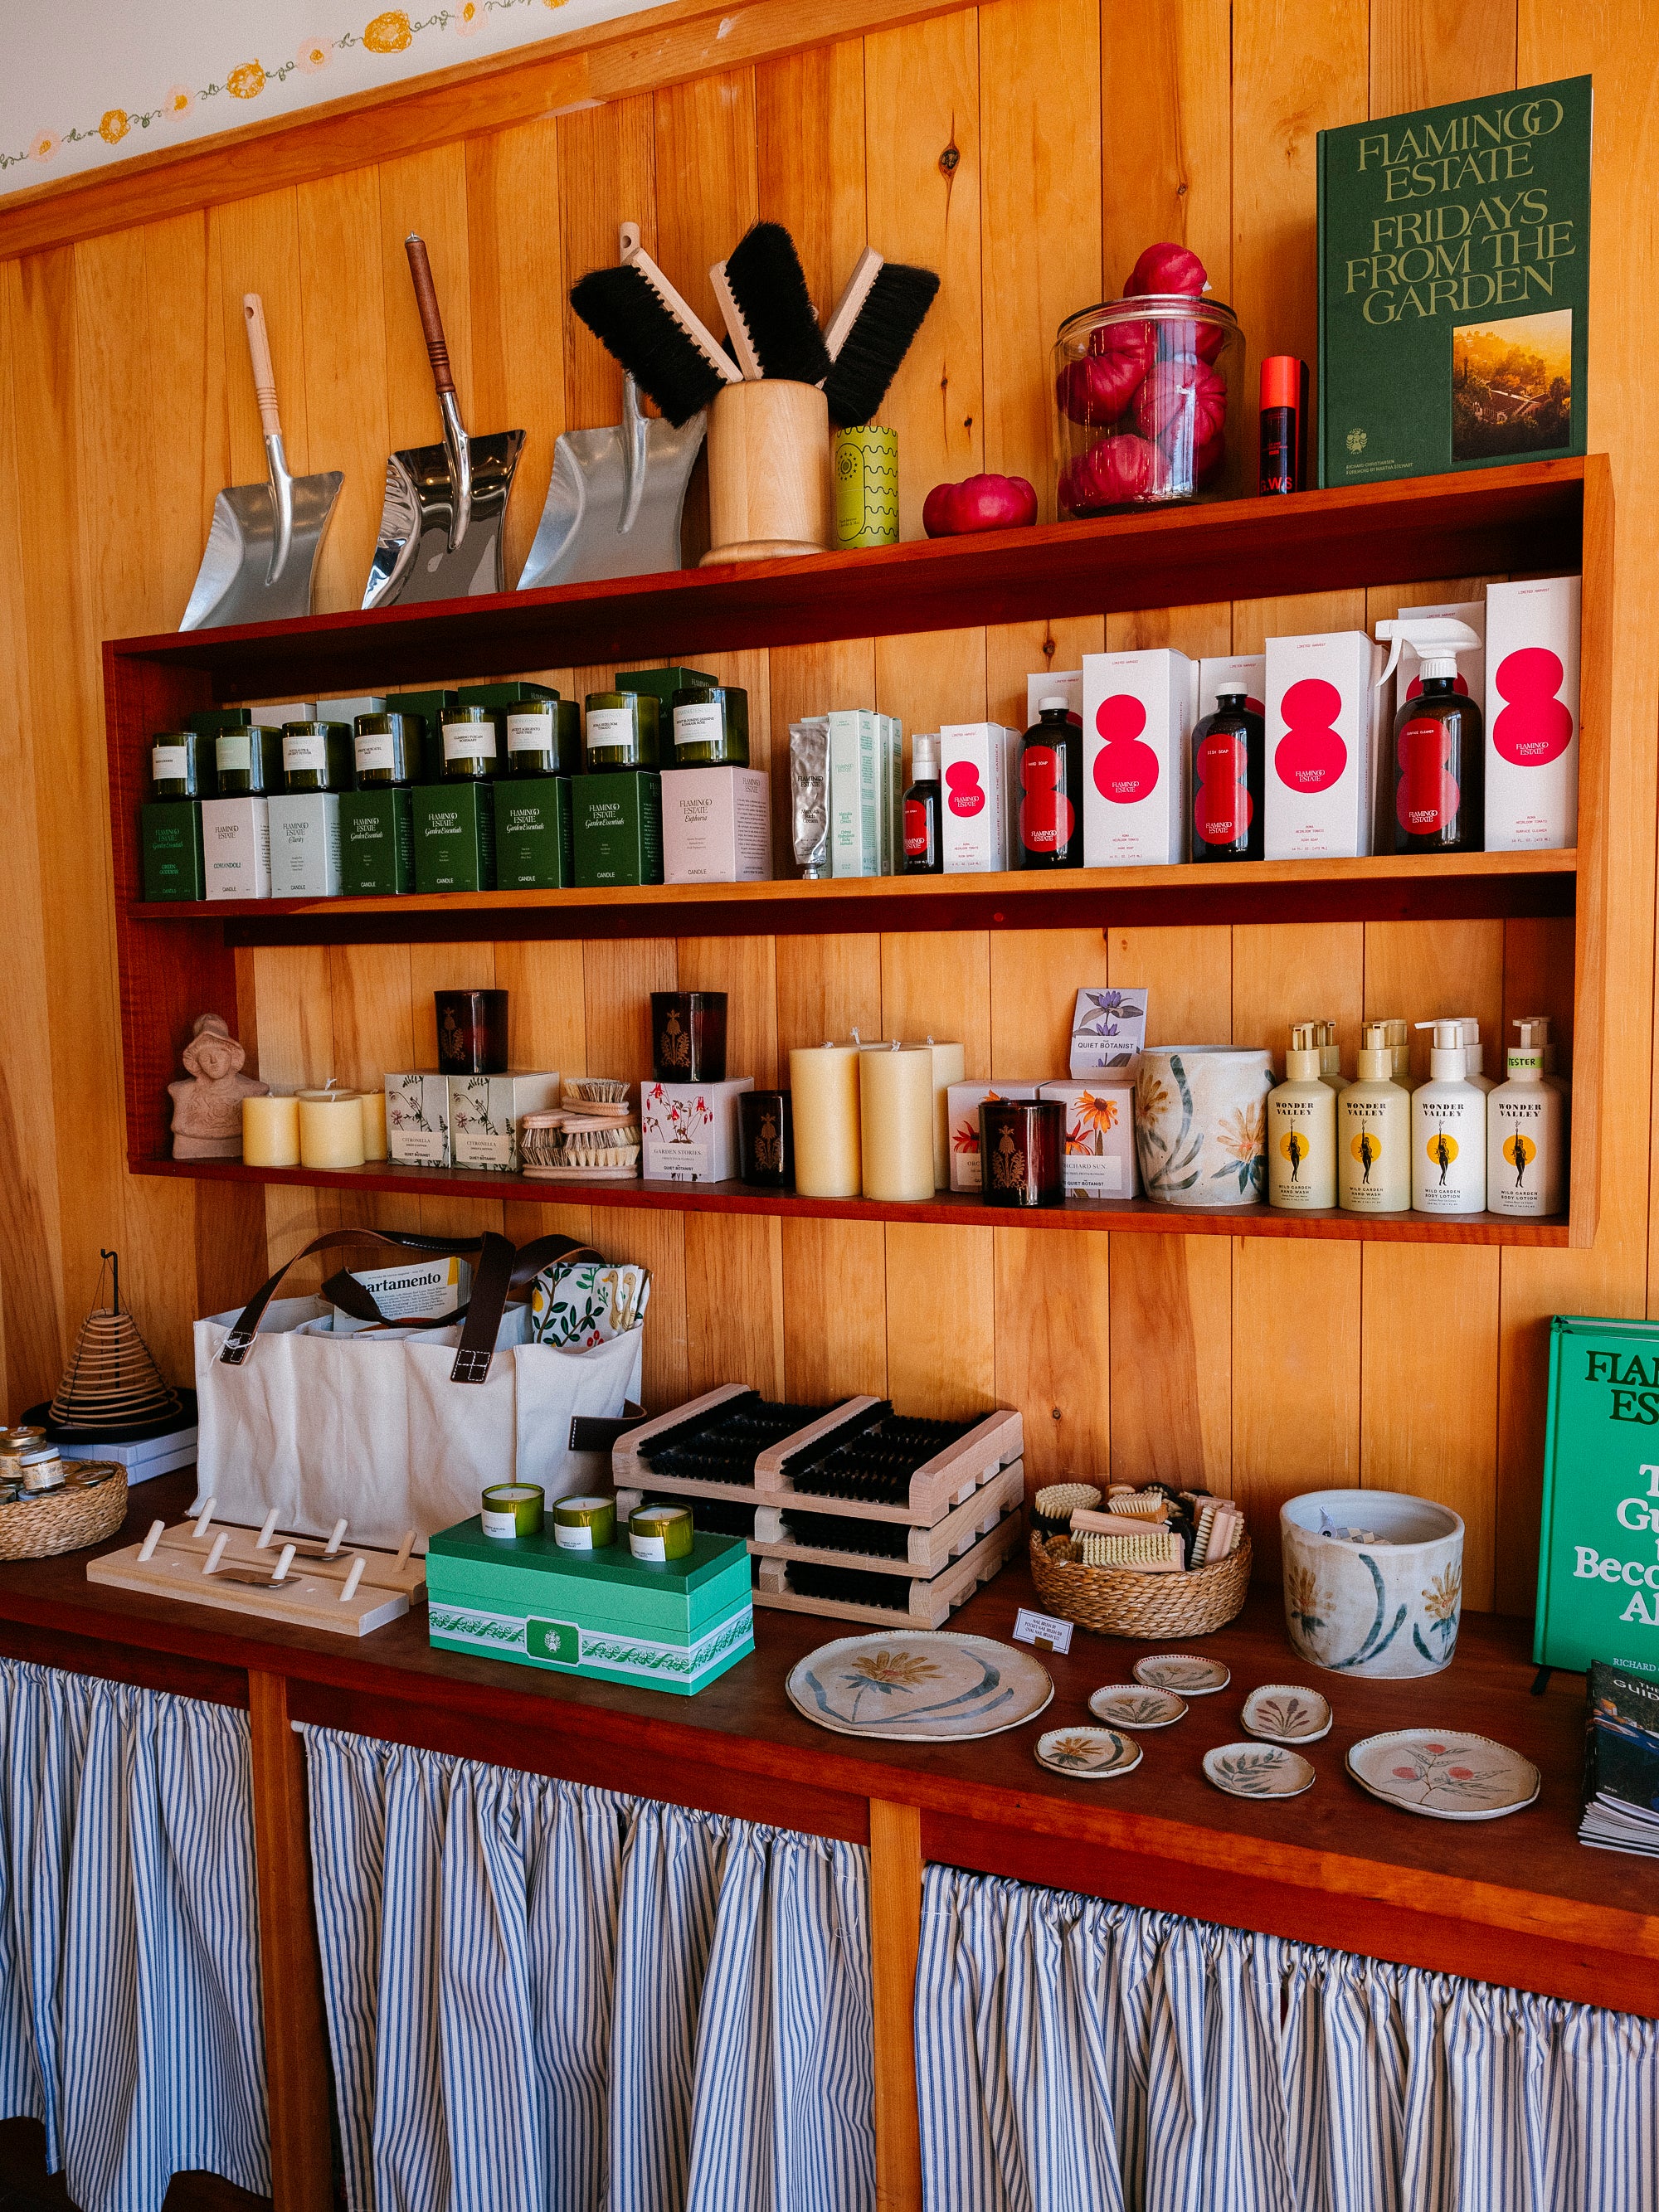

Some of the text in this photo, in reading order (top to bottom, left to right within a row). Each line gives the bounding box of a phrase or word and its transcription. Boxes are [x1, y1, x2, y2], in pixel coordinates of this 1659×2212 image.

[1357, 98, 1564, 172] FLAMINGO
[1384, 141, 1535, 203] ESTATE
[1371, 188, 1549, 253] FRIDAYS
[1344, 221, 1576, 294] FROM THE
[1362, 261, 1557, 325] GARDEN
[1515, 741, 1549, 751] FLAMINGO
[1295, 769, 1326, 777] FLAMINGO
[1112, 780, 1140, 789] FLAMINGO
[589, 803, 620, 812] FLAMINGO
[679, 799, 713, 808] FLAMINGO
[509, 808, 540, 817] FLAMINGO
[593, 810, 616, 819] ESTATE
[684, 806, 708, 815] ESTATE
[1409, 809, 1438, 818] FLAMINGO
[428, 812, 458, 821] FLAMINGO
[513, 815, 537, 824] ESTATE
[684, 814, 708, 824] Euphoria
[283, 822, 309, 830] FLAMINGO
[353, 817, 380, 826] FLAMINGO
[432, 819, 454, 828] ESTATE
[585, 817, 625, 829] Garden Essentials
[215, 825, 239, 834] FLAMINGO
[357, 824, 377, 833] ESTATE
[1031, 829, 1058, 838] FLAMINGO
[1508, 1057, 1536, 1067] TESTER
[1276, 1101, 1314, 1110] WONDER
[1346, 1102, 1387, 1111] WONDER
[363, 1271, 442, 1294] artamento
[1613, 1657, 1657, 1672] RICHARD
